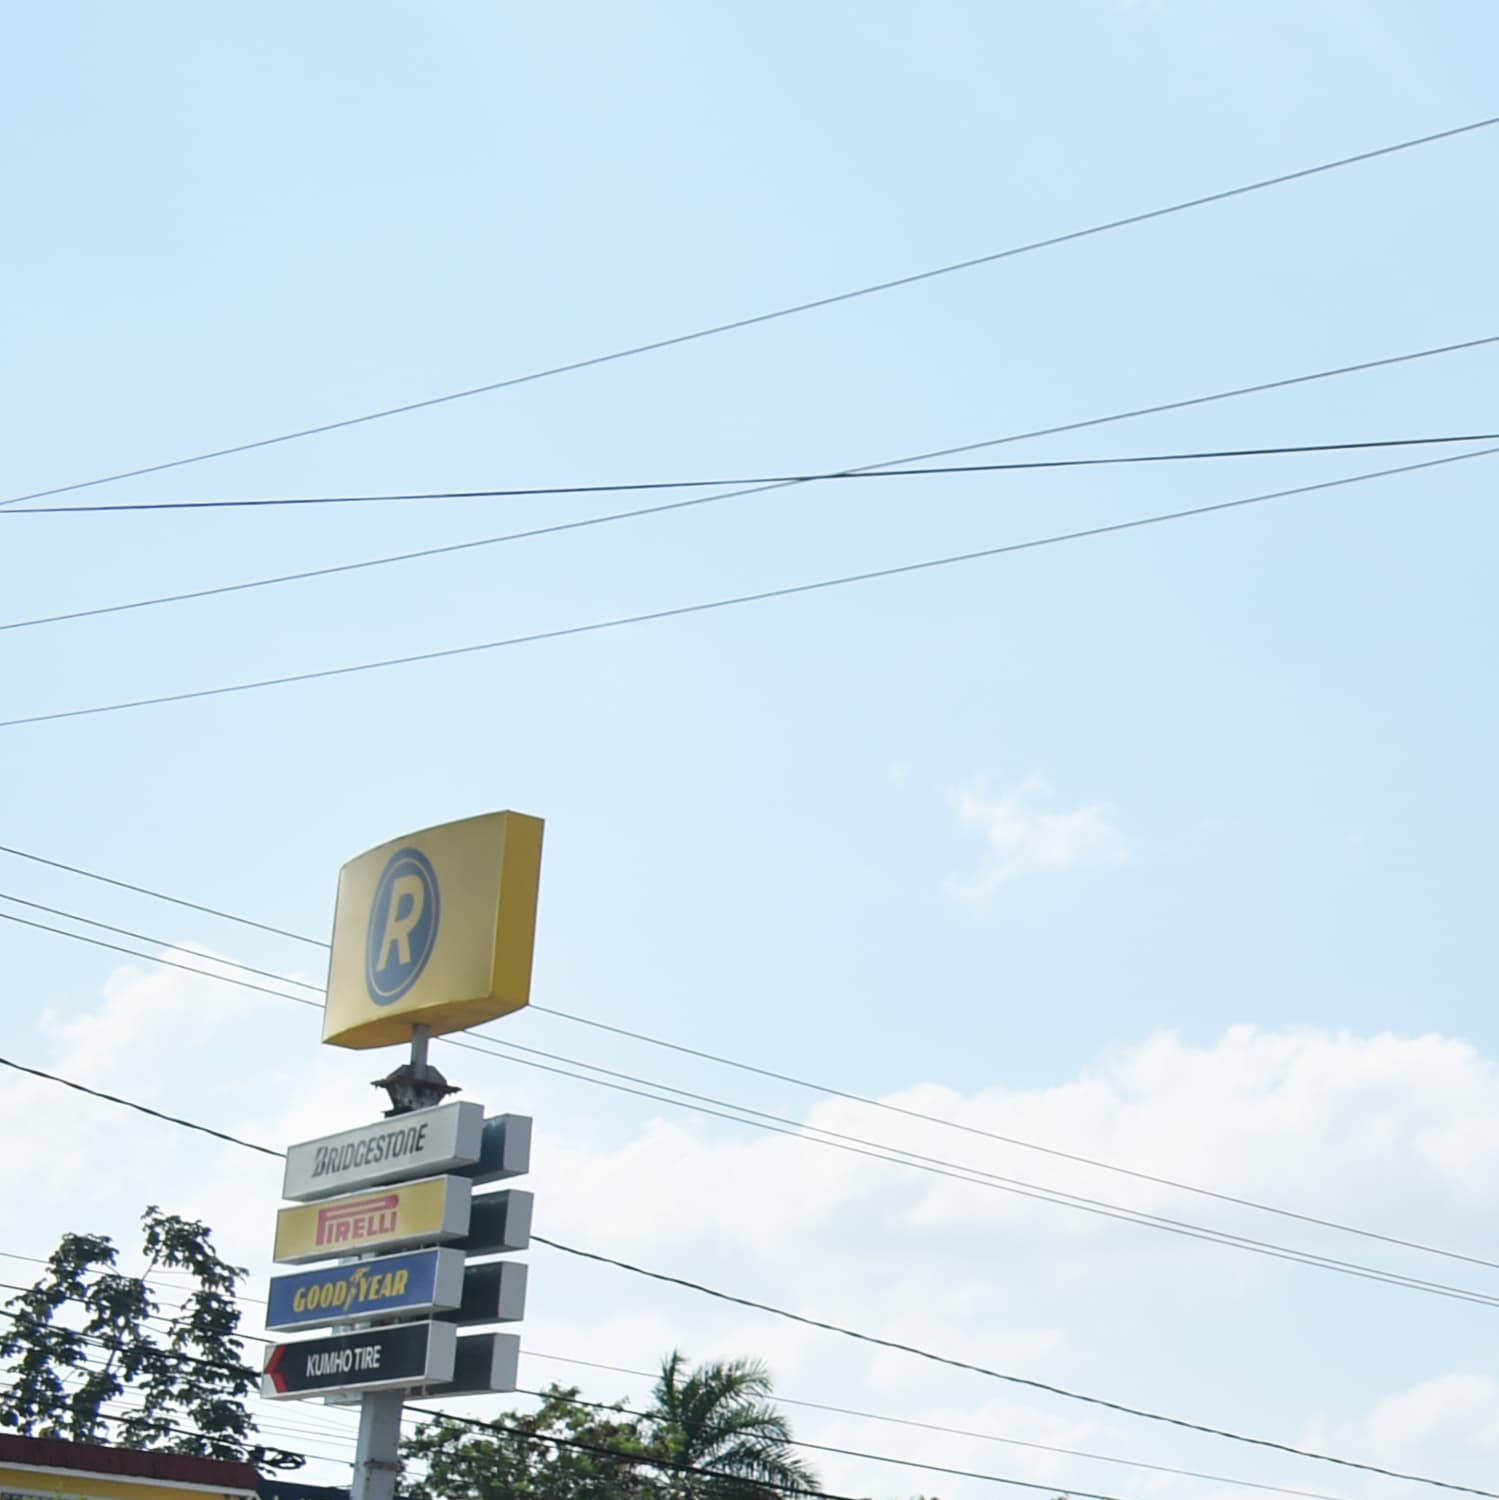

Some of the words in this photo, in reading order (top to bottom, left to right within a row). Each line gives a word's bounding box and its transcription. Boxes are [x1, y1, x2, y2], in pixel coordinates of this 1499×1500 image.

[311, 1122, 427, 1178] BRIDGESTONE
[315, 1193, 399, 1247] PIRELLI
[306, 1346, 352, 1377] KUMHO
[353, 1344, 381, 1371] TIRE
